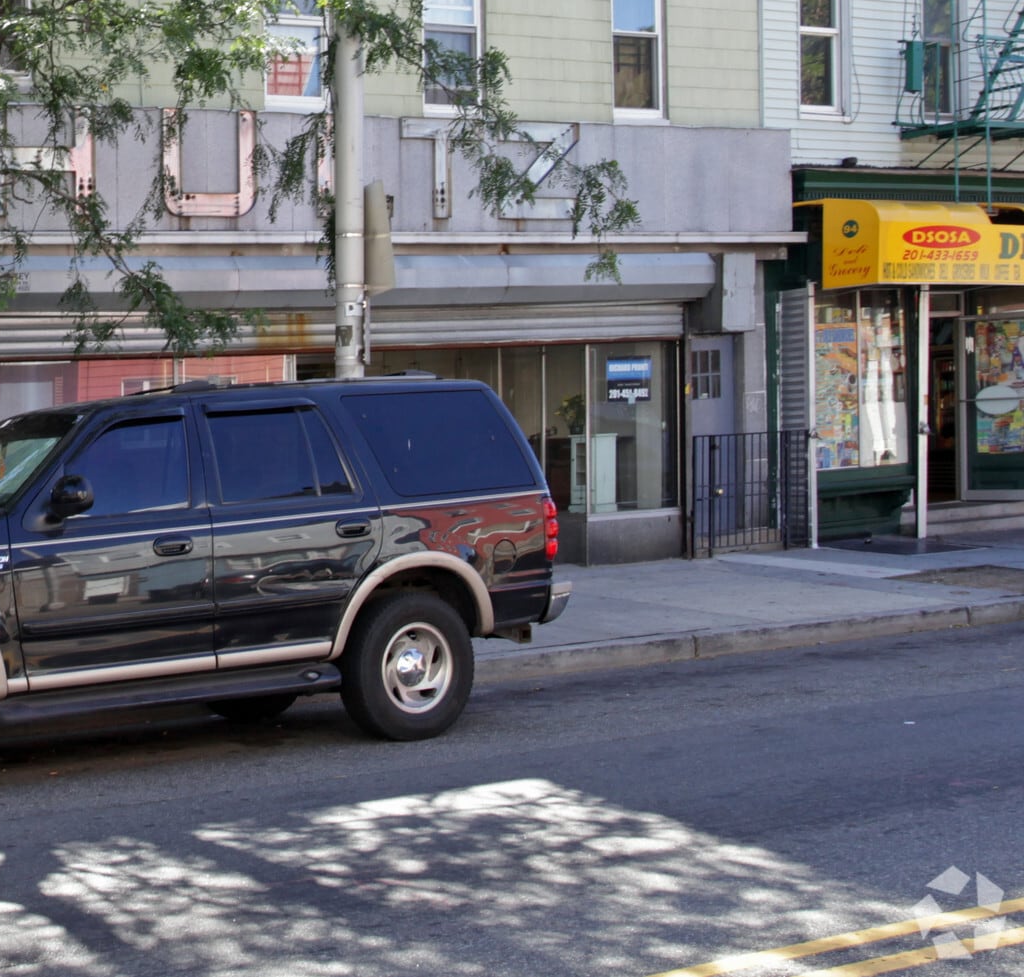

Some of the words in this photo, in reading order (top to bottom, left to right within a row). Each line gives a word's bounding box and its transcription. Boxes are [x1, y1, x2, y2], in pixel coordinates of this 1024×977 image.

[912, 231, 971, 243] DSOSA
[999, 232, 1024, 260] D
[903, 250, 979, 261] 201-433-1659
[828, 264, 871, 279] Grocery
